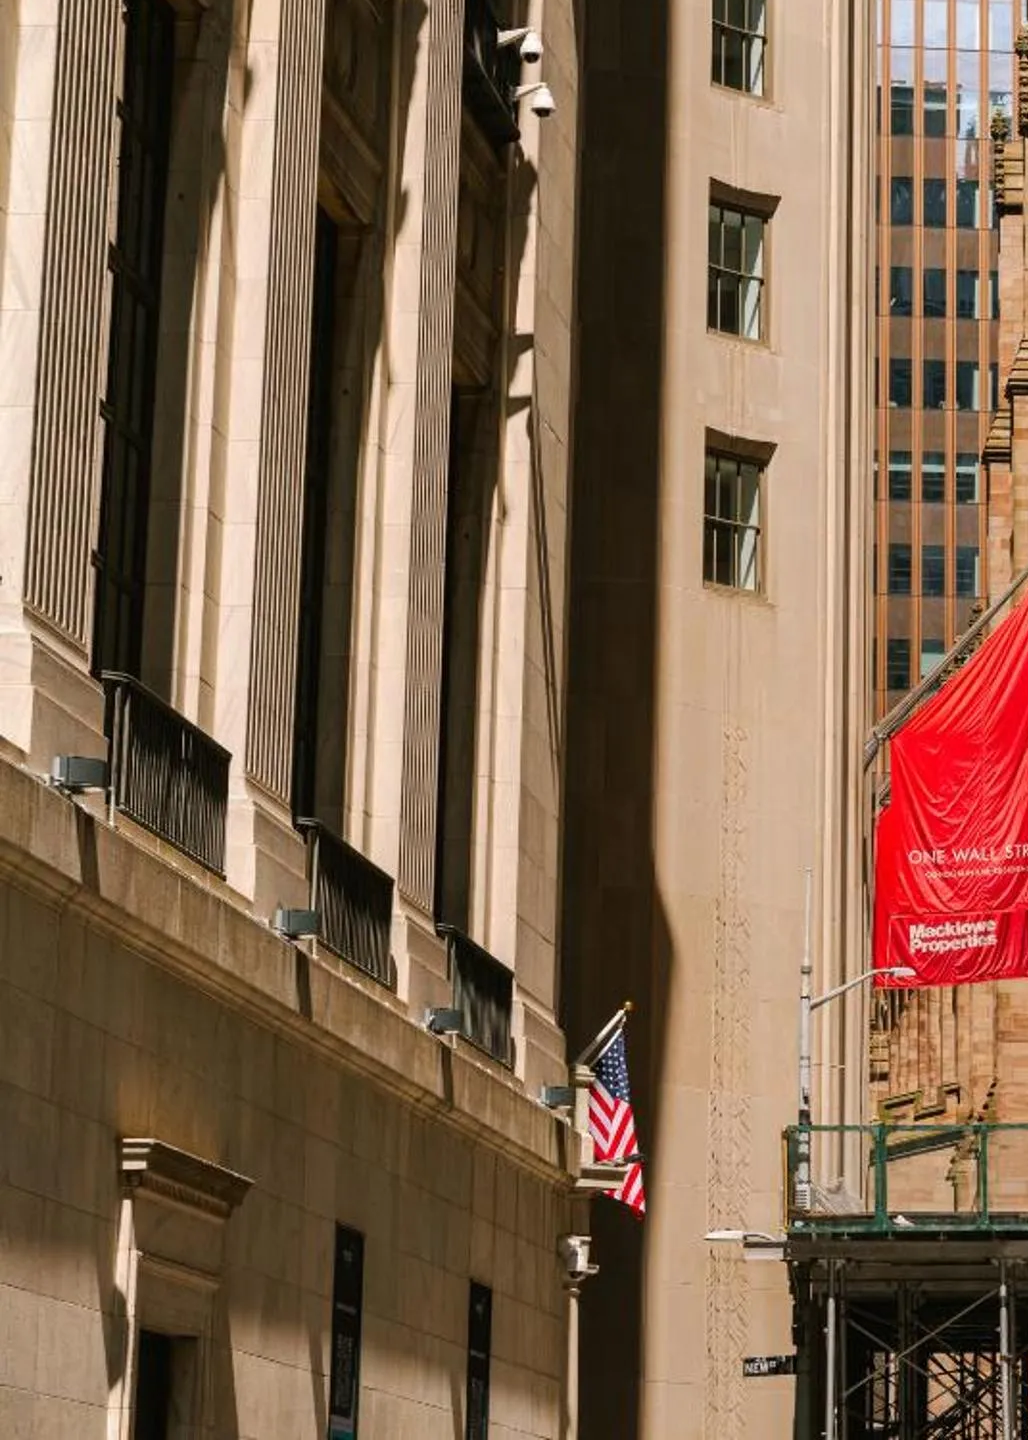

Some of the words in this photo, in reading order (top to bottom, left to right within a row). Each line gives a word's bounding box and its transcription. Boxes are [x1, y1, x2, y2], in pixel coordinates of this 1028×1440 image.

[907, 849, 945, 865] ONE
[952, 846, 999, 862] WALL
[909, 934, 998, 955] Properties
